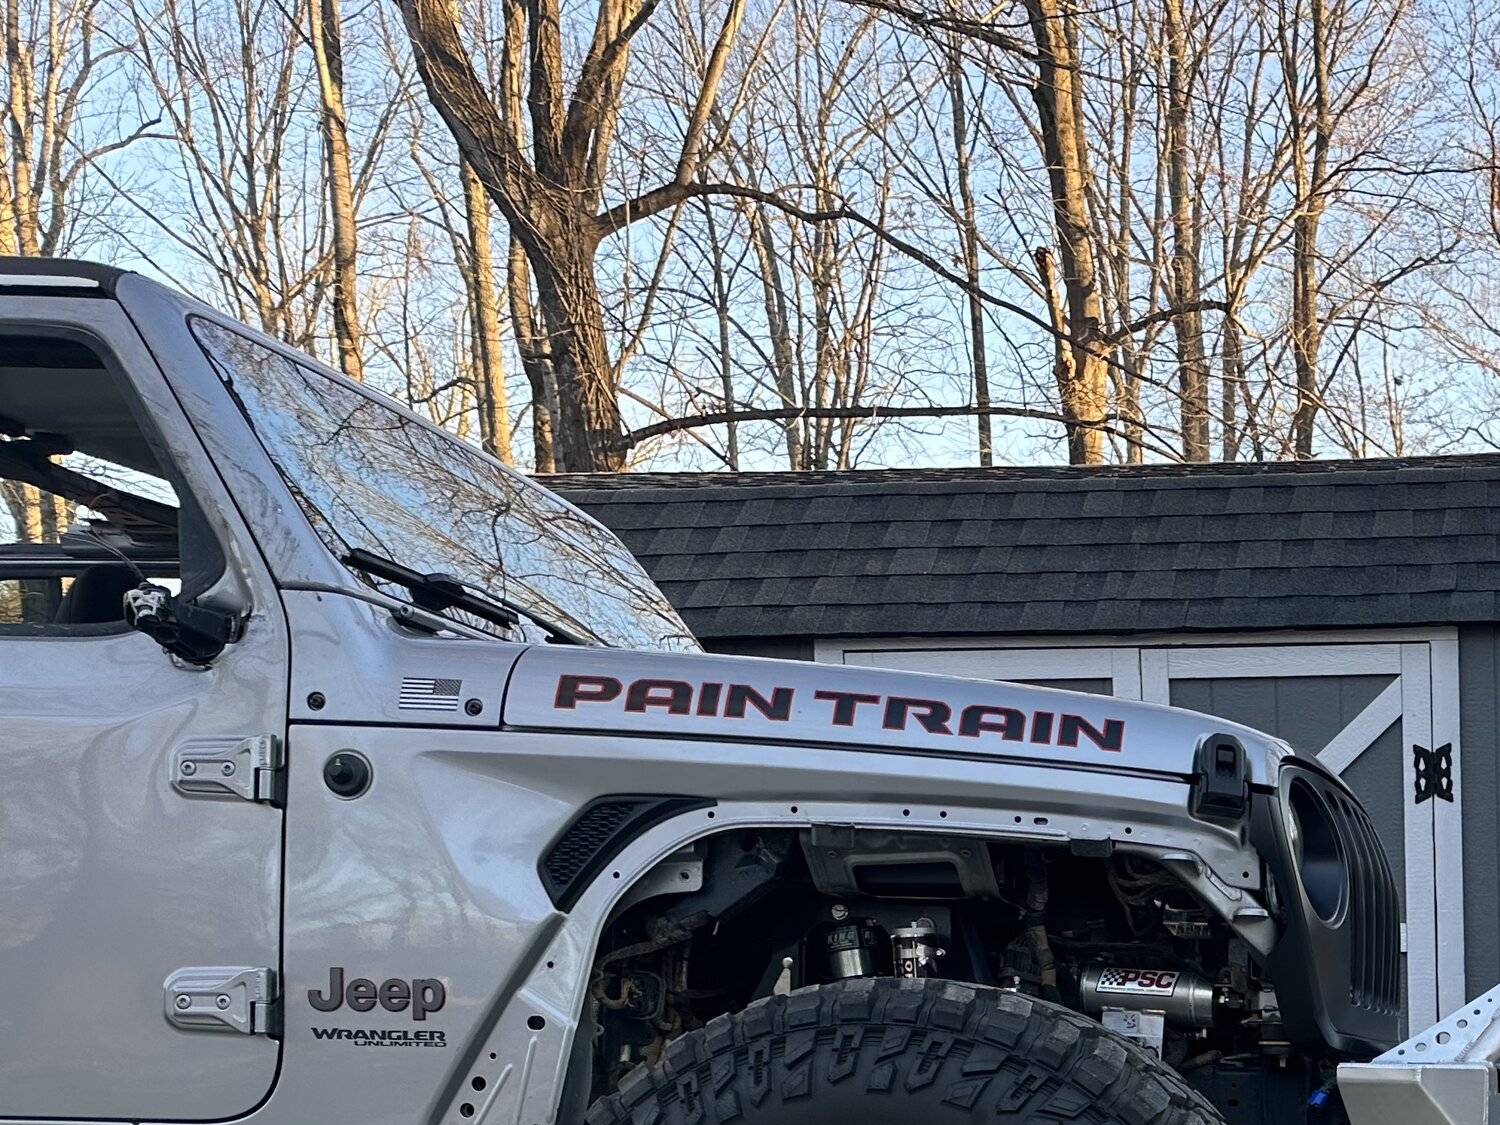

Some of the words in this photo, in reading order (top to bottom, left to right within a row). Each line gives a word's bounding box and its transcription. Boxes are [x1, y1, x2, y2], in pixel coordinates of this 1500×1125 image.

[553, 674, 795, 722] PAIN
[814, 689, 1125, 752] TRAIN
[1116, 969, 1176, 989] PSC
[308, 967, 446, 1021] Jeep
[311, 1027, 446, 1041] WRANGLER
[354, 1040, 447, 1048] UNLIMITED
